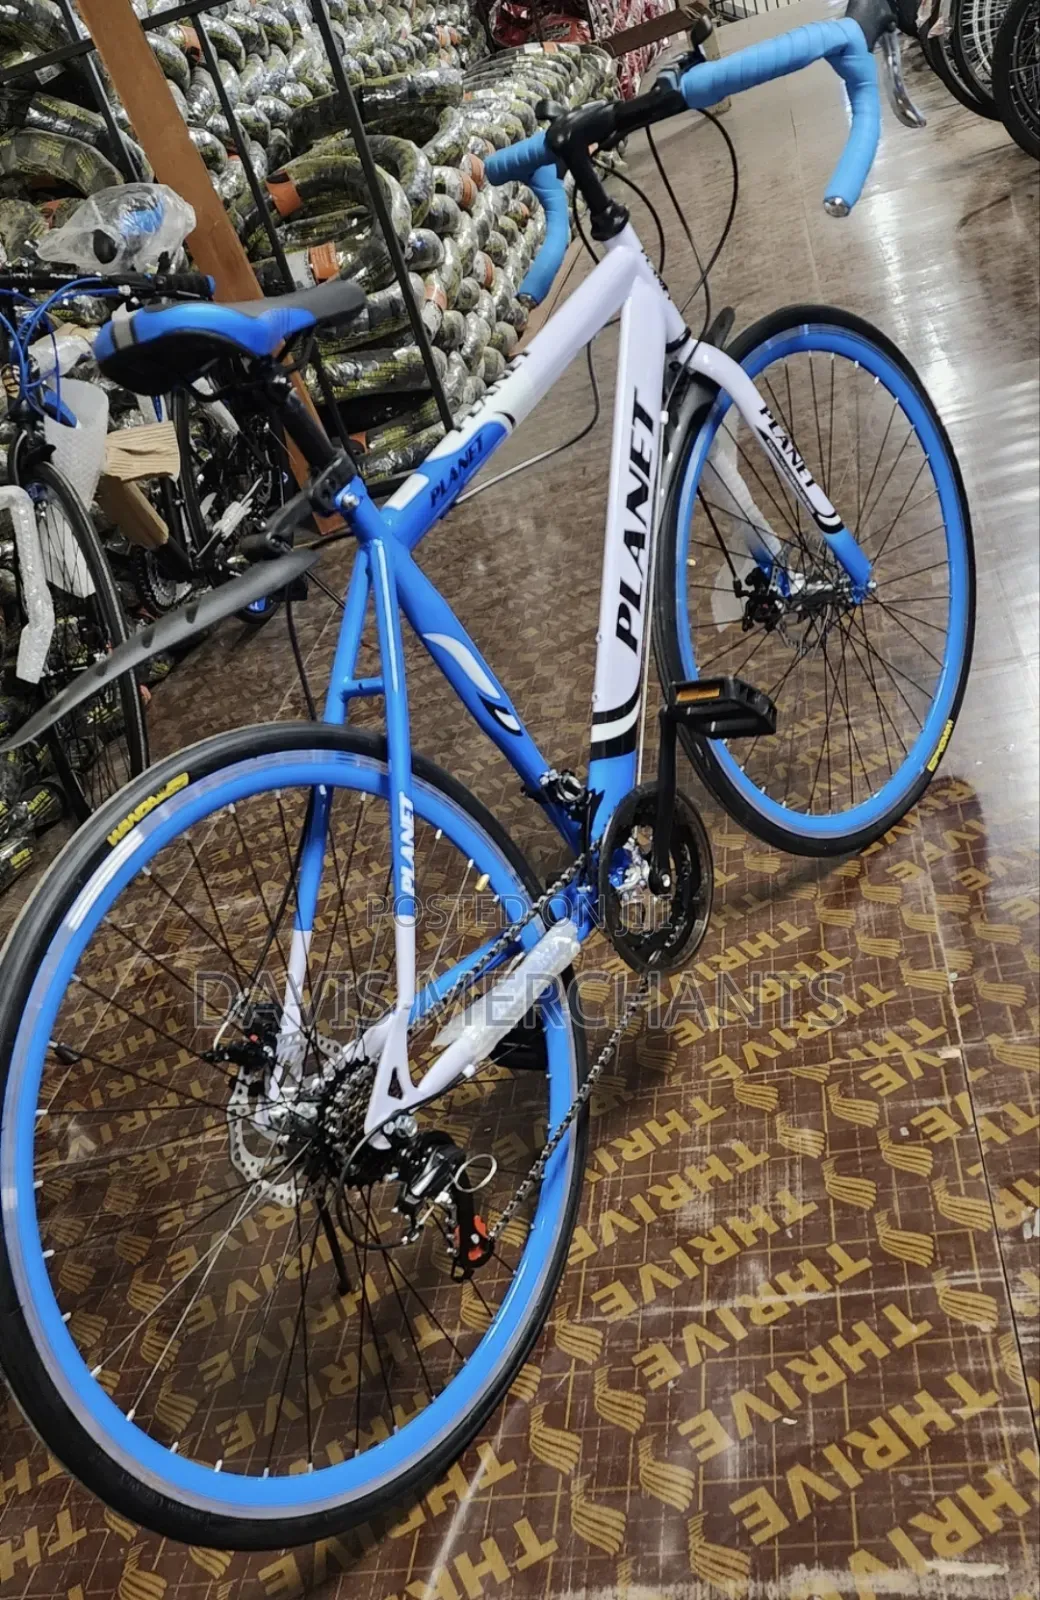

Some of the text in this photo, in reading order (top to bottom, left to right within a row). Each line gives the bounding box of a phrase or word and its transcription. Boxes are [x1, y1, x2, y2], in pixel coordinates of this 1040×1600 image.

[429, 434, 484, 508] PLANET
[759, 405, 815, 487] PLANET
[615, 385, 654, 656] PLANET
[399, 791, 415, 897] PLANET
[644, 919, 812, 1012] THRIVE
[666, 949, 853, 1047] THRIVE
[701, 982, 898, 1079] THRIVE
[585, 1096, 727, 1183] THRI
[567, 1140, 769, 1266] THRIVE
[591, 1187, 819, 1323] THRIVE
[631, 1243, 873, 1390] THRIVE
[214, 1312, 445, 1460] THRIVE
[677, 1303, 933, 1462] THRIVE
[730, 1371, 1001, 1546] THRIVE
